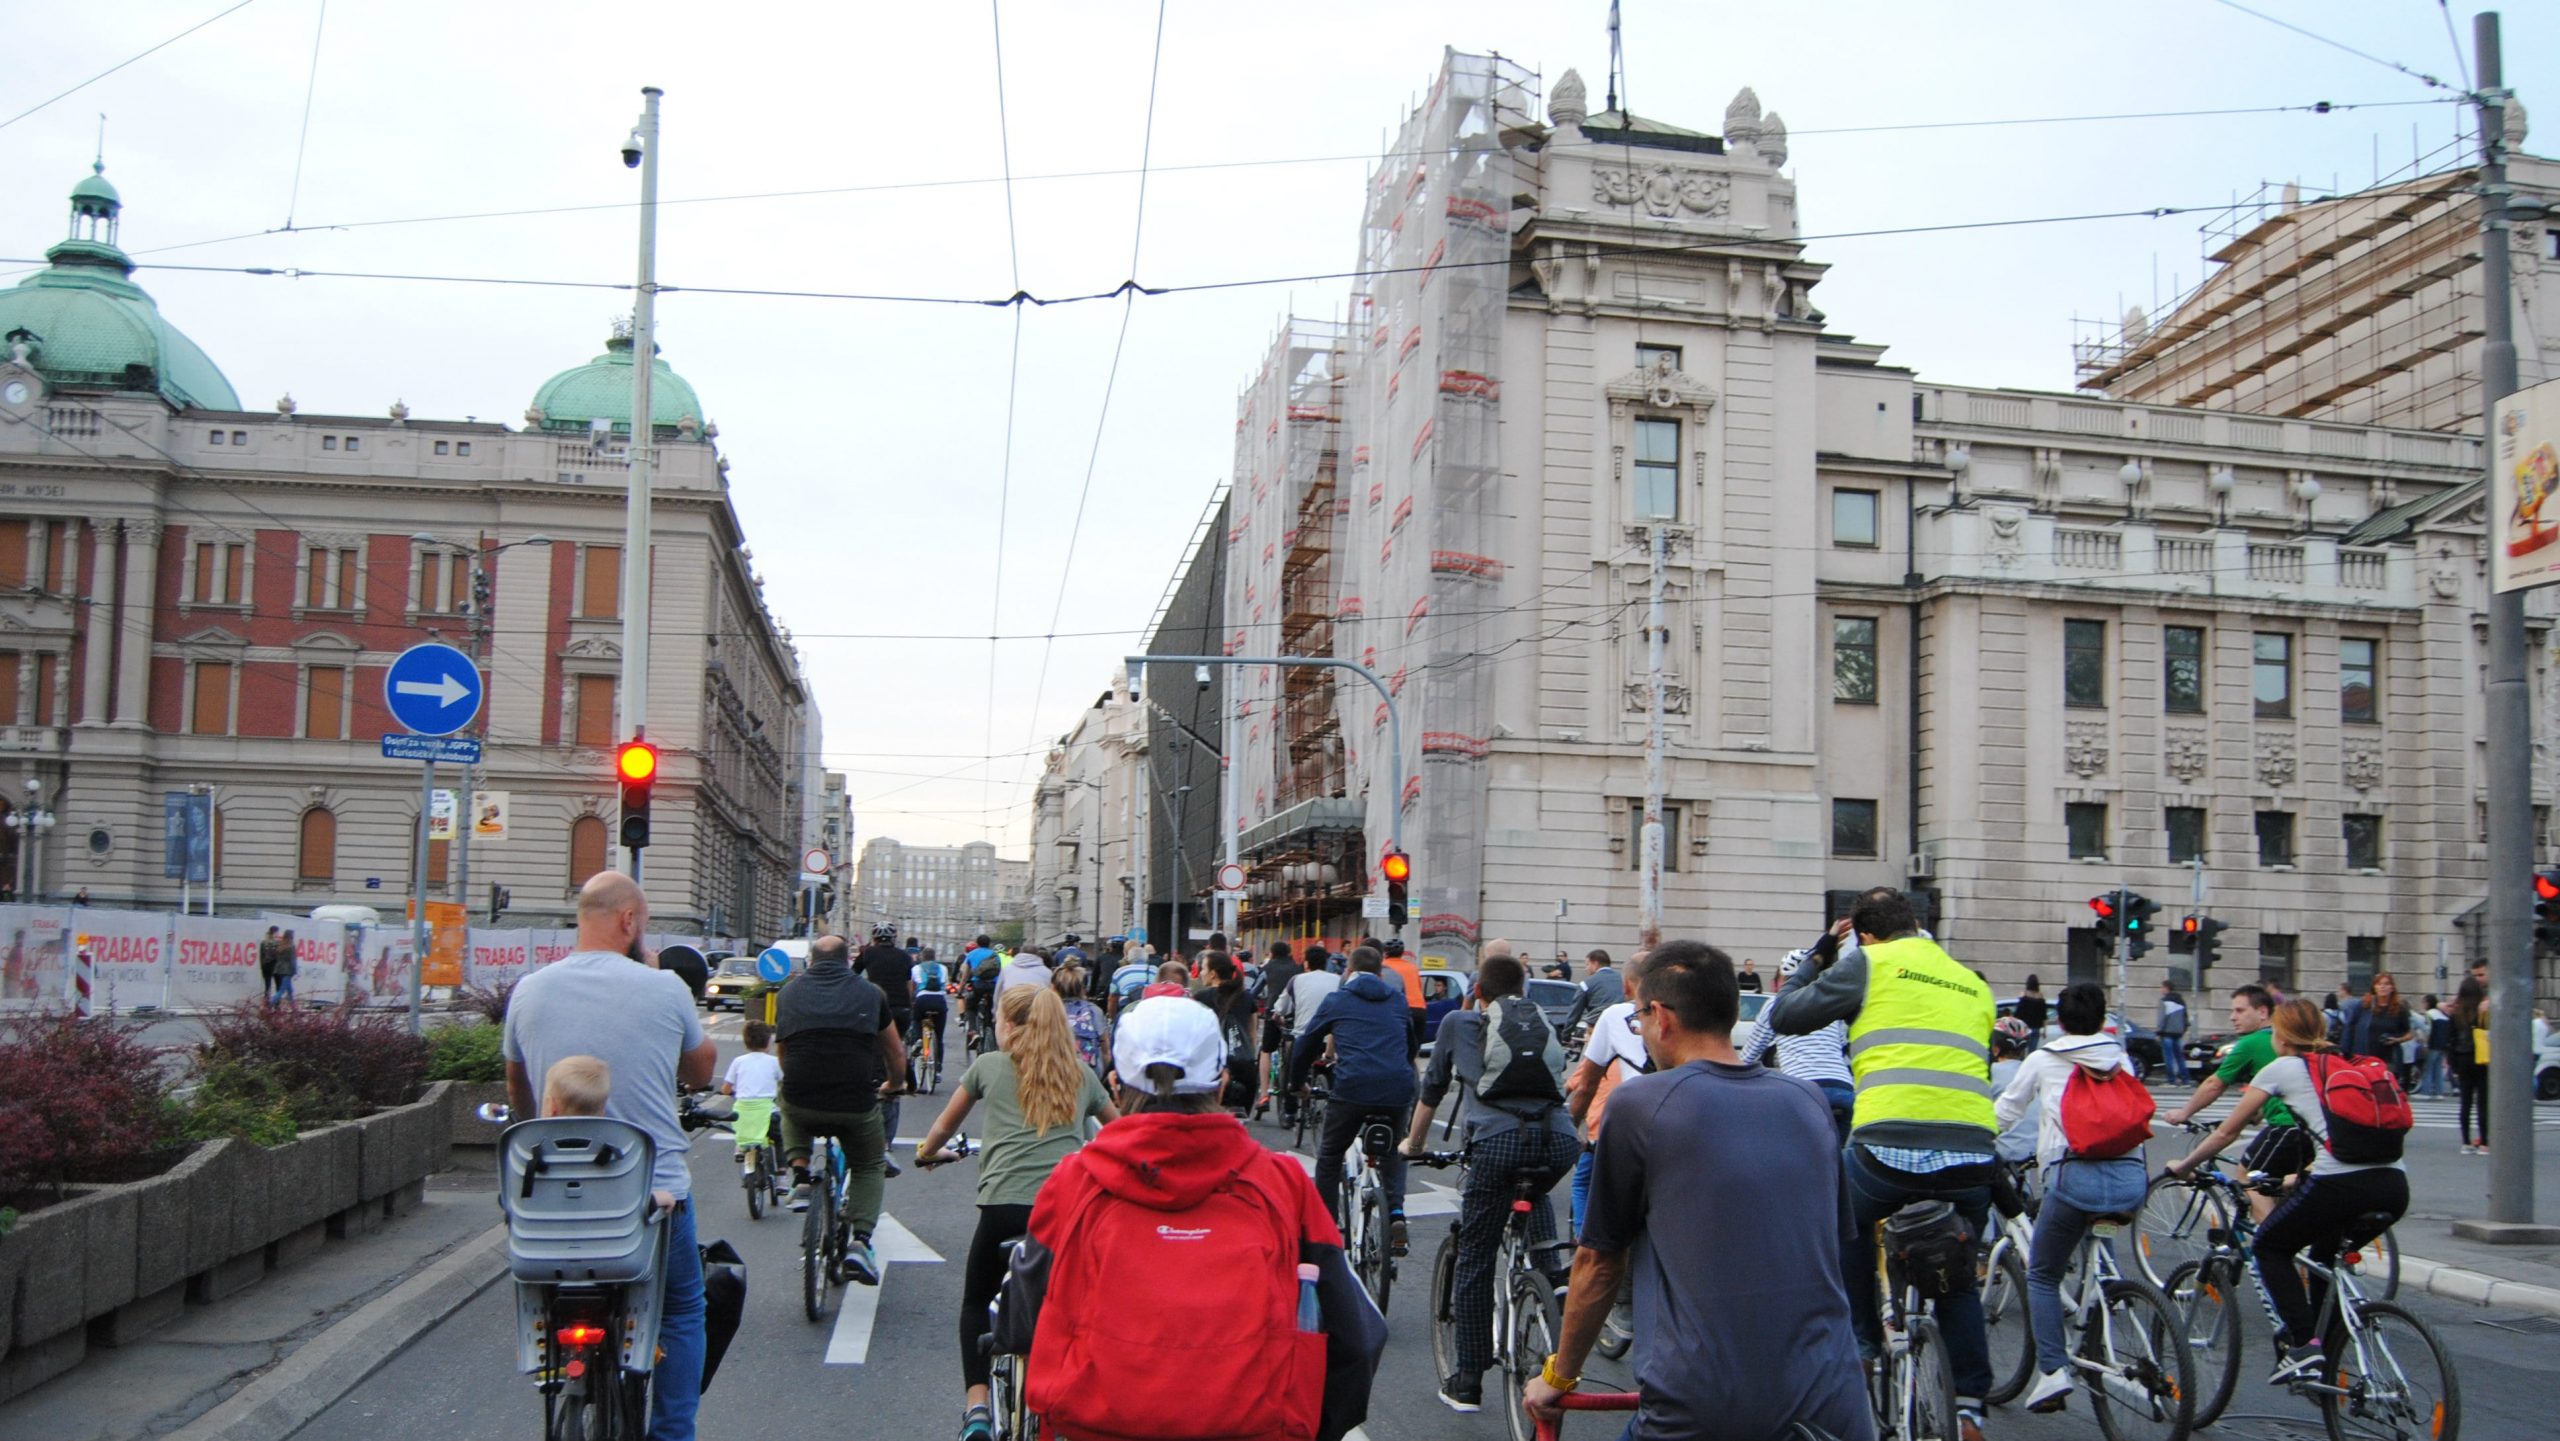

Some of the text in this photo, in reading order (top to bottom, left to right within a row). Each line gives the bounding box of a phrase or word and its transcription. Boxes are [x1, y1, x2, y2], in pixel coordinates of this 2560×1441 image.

[88, 935, 159, 963] TRABAG
[180, 939, 257, 967] STRABAG
[295, 938, 337, 965] ABAG
[474, 946, 526, 966] STRABAG
[1896, 968, 1979, 998] BRIDGESTONE
[1156, 1225, 1212, 1236] Champion
